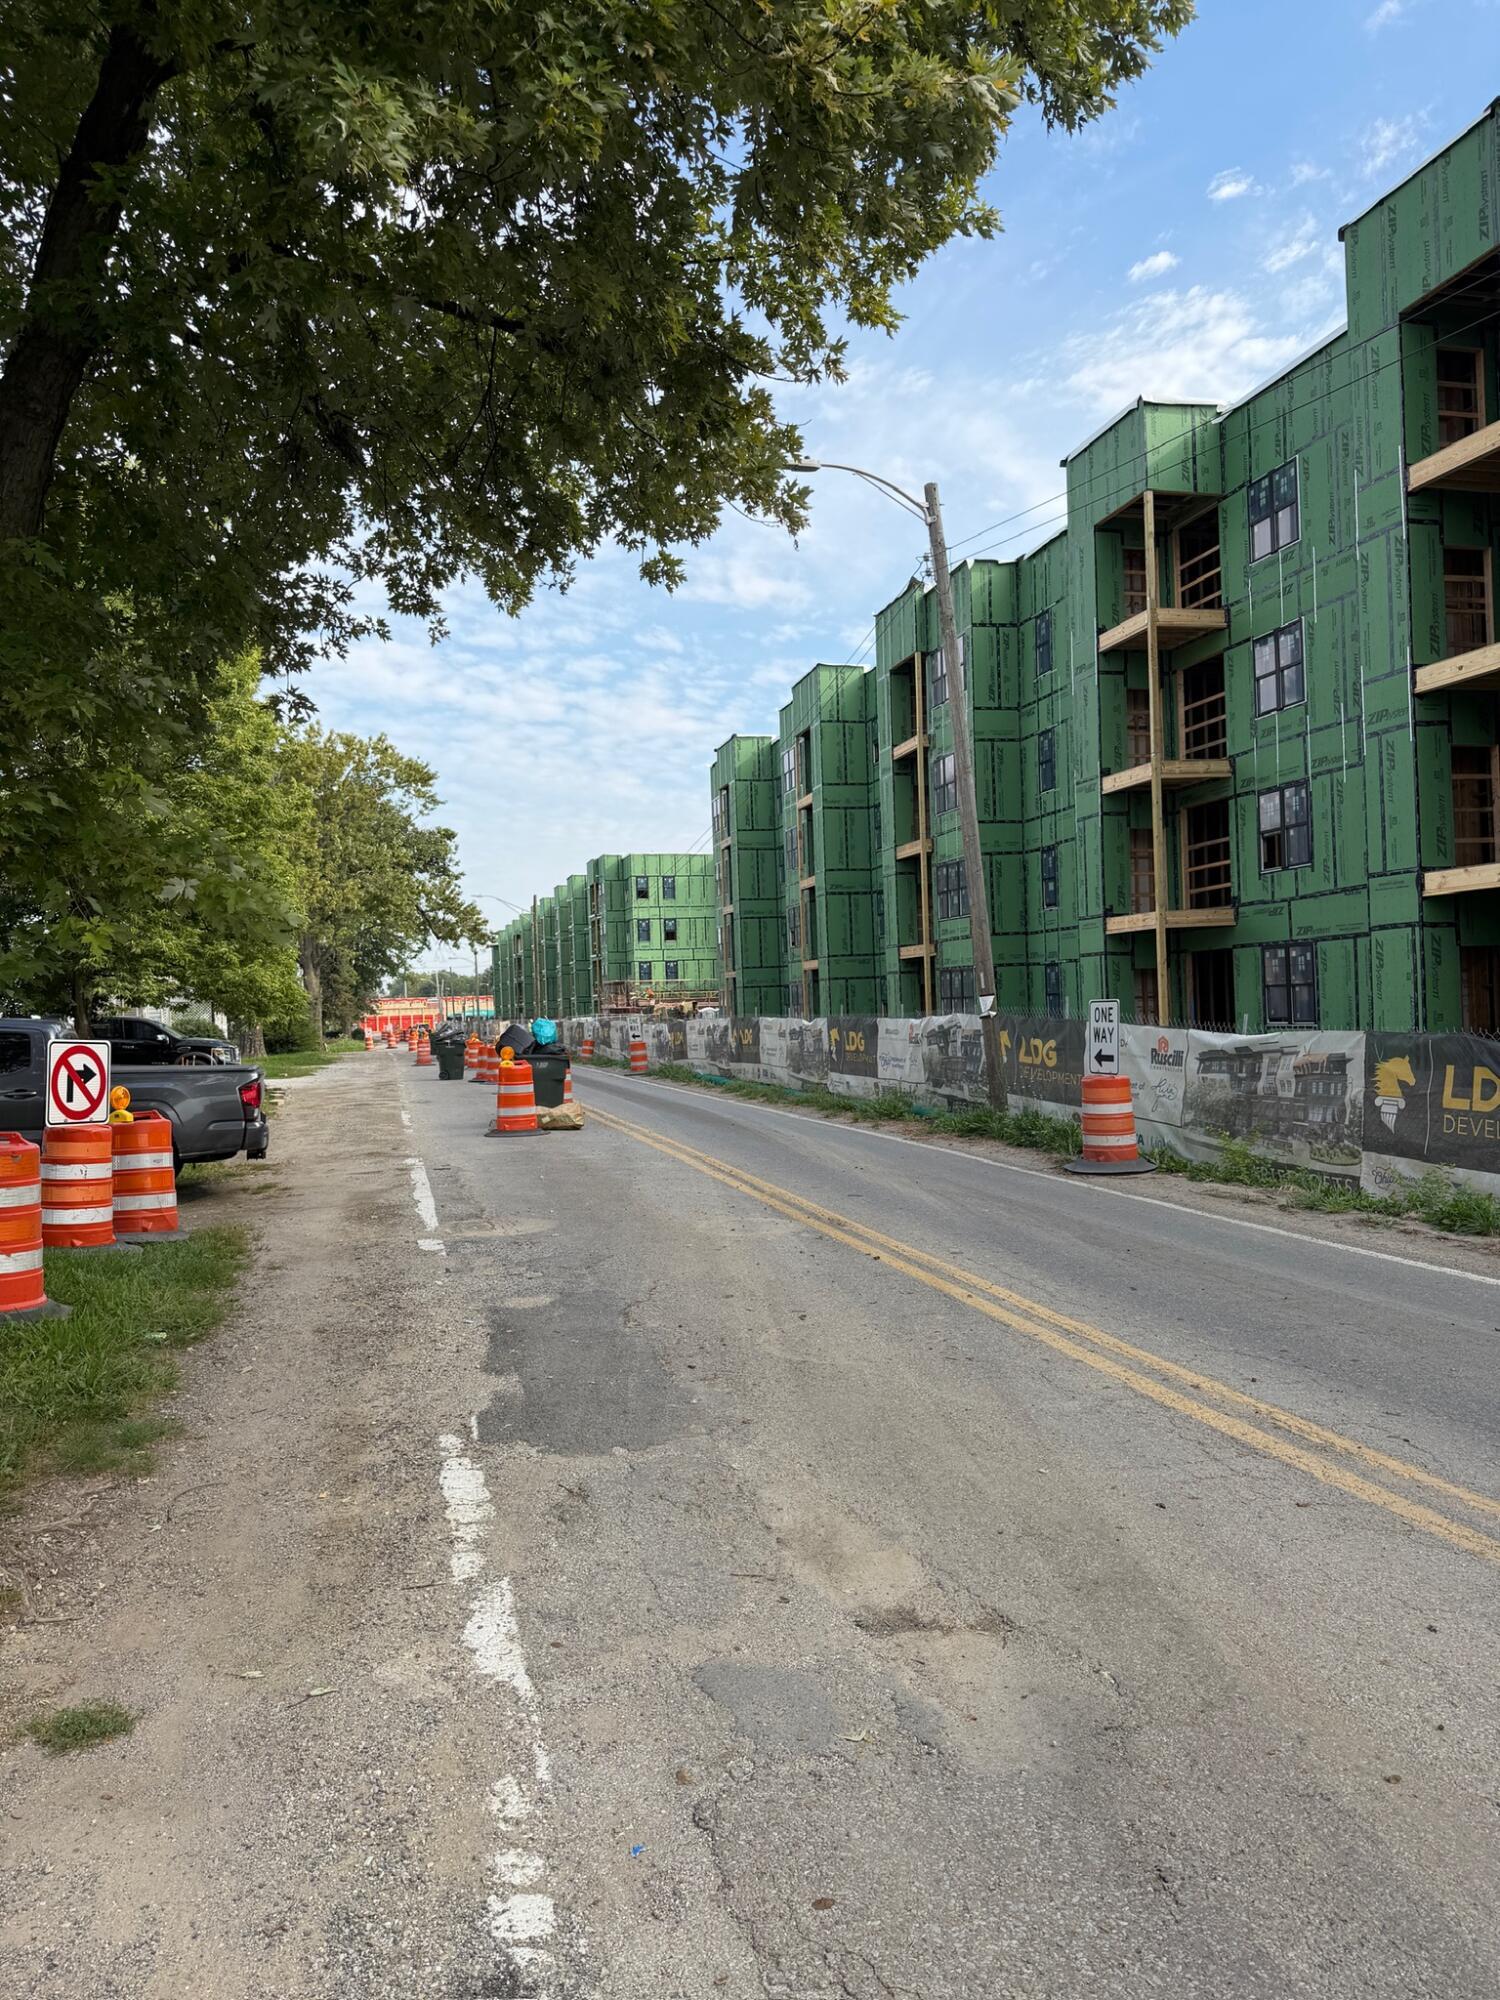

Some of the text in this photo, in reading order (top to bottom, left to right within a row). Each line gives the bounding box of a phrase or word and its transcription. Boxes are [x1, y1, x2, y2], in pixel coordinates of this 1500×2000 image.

[1094, 1007, 1114, 1023] ONE
[844, 1030, 865, 1053] LDG
[1093, 1027, 1114, 1043] WAY
[1018, 1035, 1058, 1068] LDG
[1150, 1047, 1184, 1068] Ruscilli
